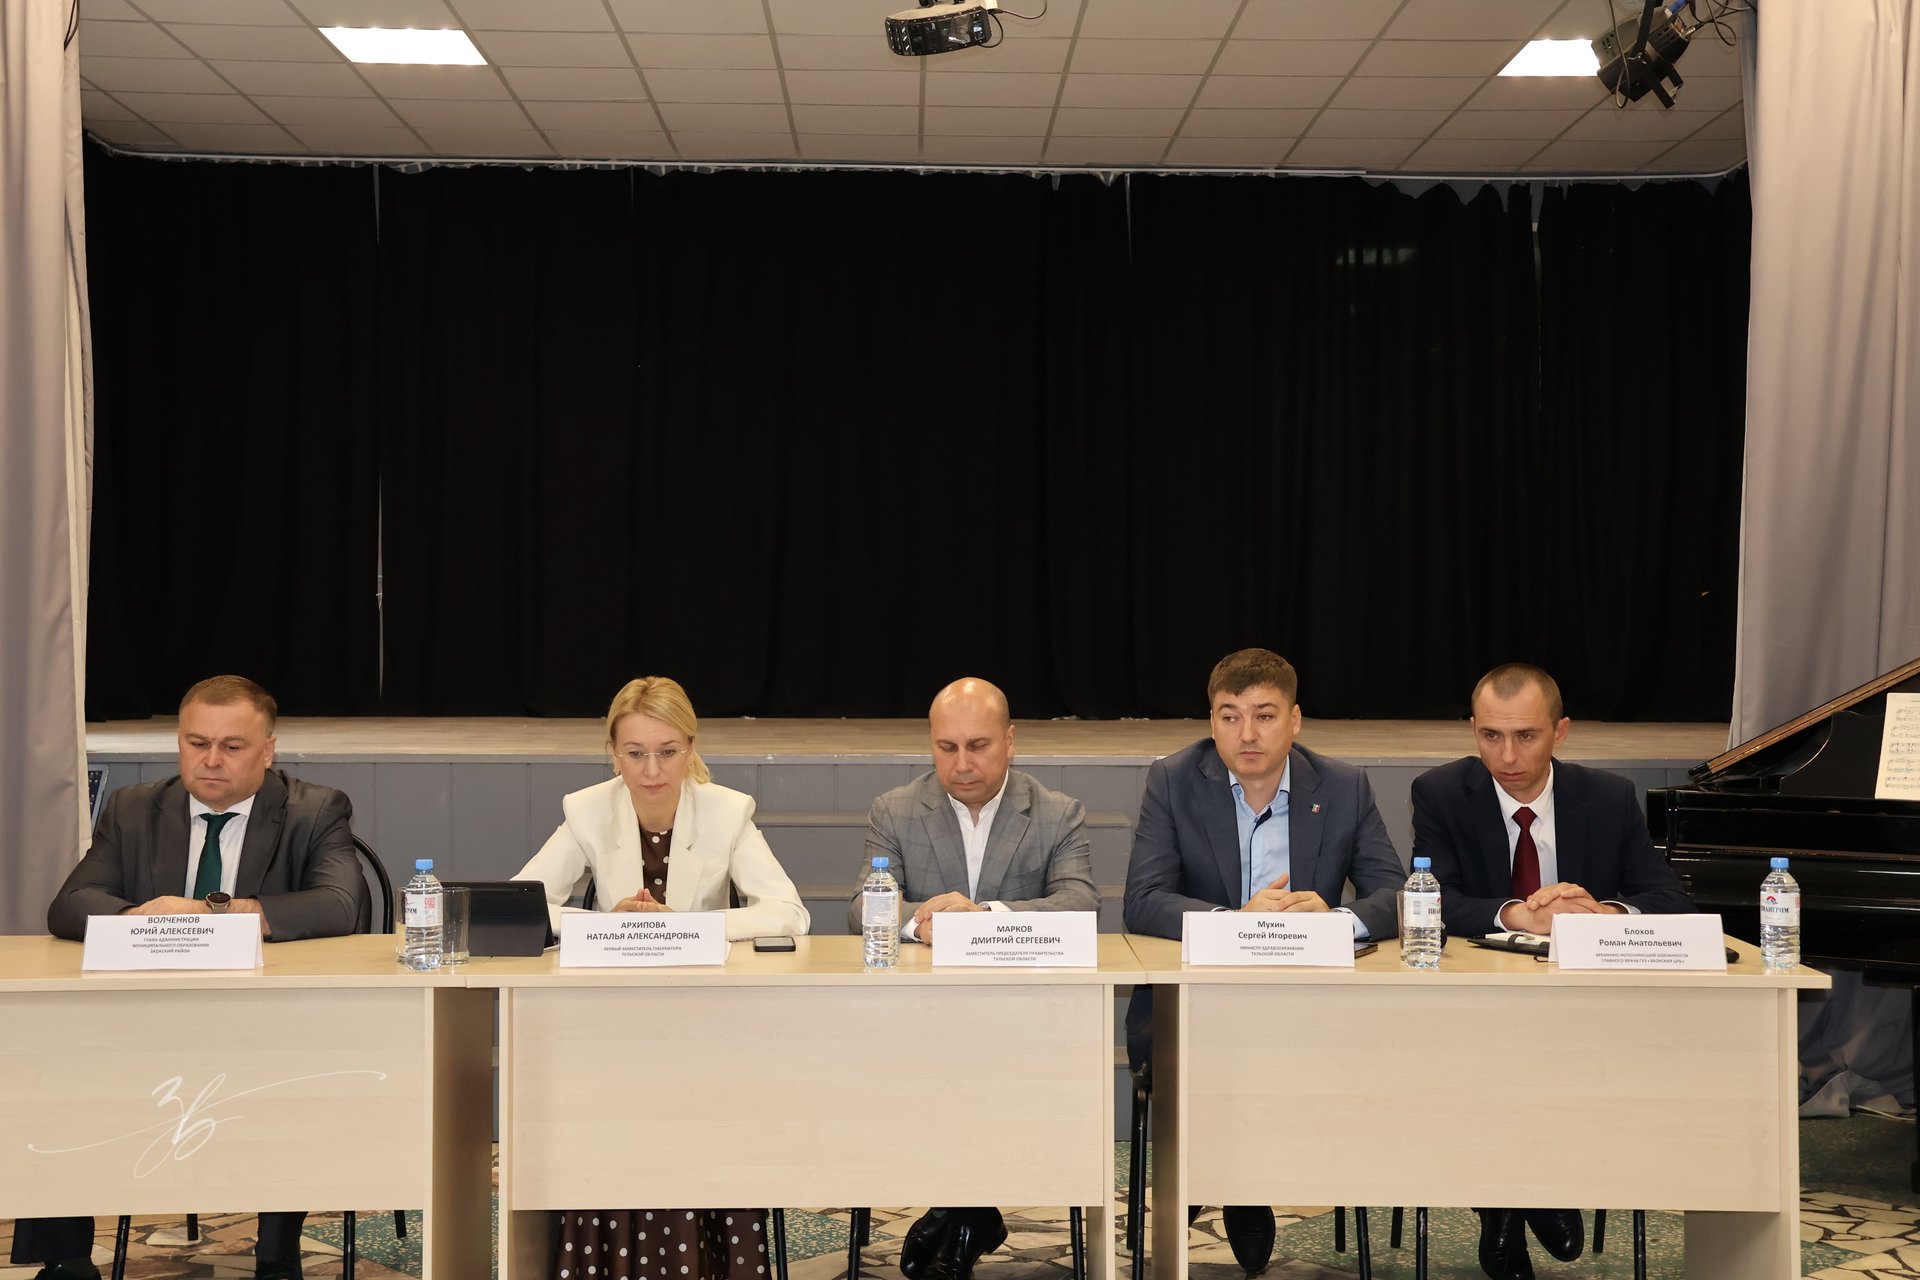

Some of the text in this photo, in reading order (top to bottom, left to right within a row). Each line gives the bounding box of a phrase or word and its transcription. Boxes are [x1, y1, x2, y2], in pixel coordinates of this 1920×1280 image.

[148, 916, 200, 924] ВОЛЧЕНКОВ
[1257, 920, 1285, 929] Мухин
[621, 921, 666, 929] АРХИПОВА
[997, 925, 1033, 933] МАРКОВ
[130, 926, 214, 935] ЮРИЙ АЛЕКСЕЕВИЧ
[586, 932, 700, 941] НАТАЛЬЯ АЛЕКСАНДРОВНА
[1238, 931, 1308, 940] Сергей Игоревич
[971, 935, 1061, 946] ДМИТРИЙ СЕРГЕЕВИЧ
[1599, 939, 1682, 947] Роман Анатольевич
